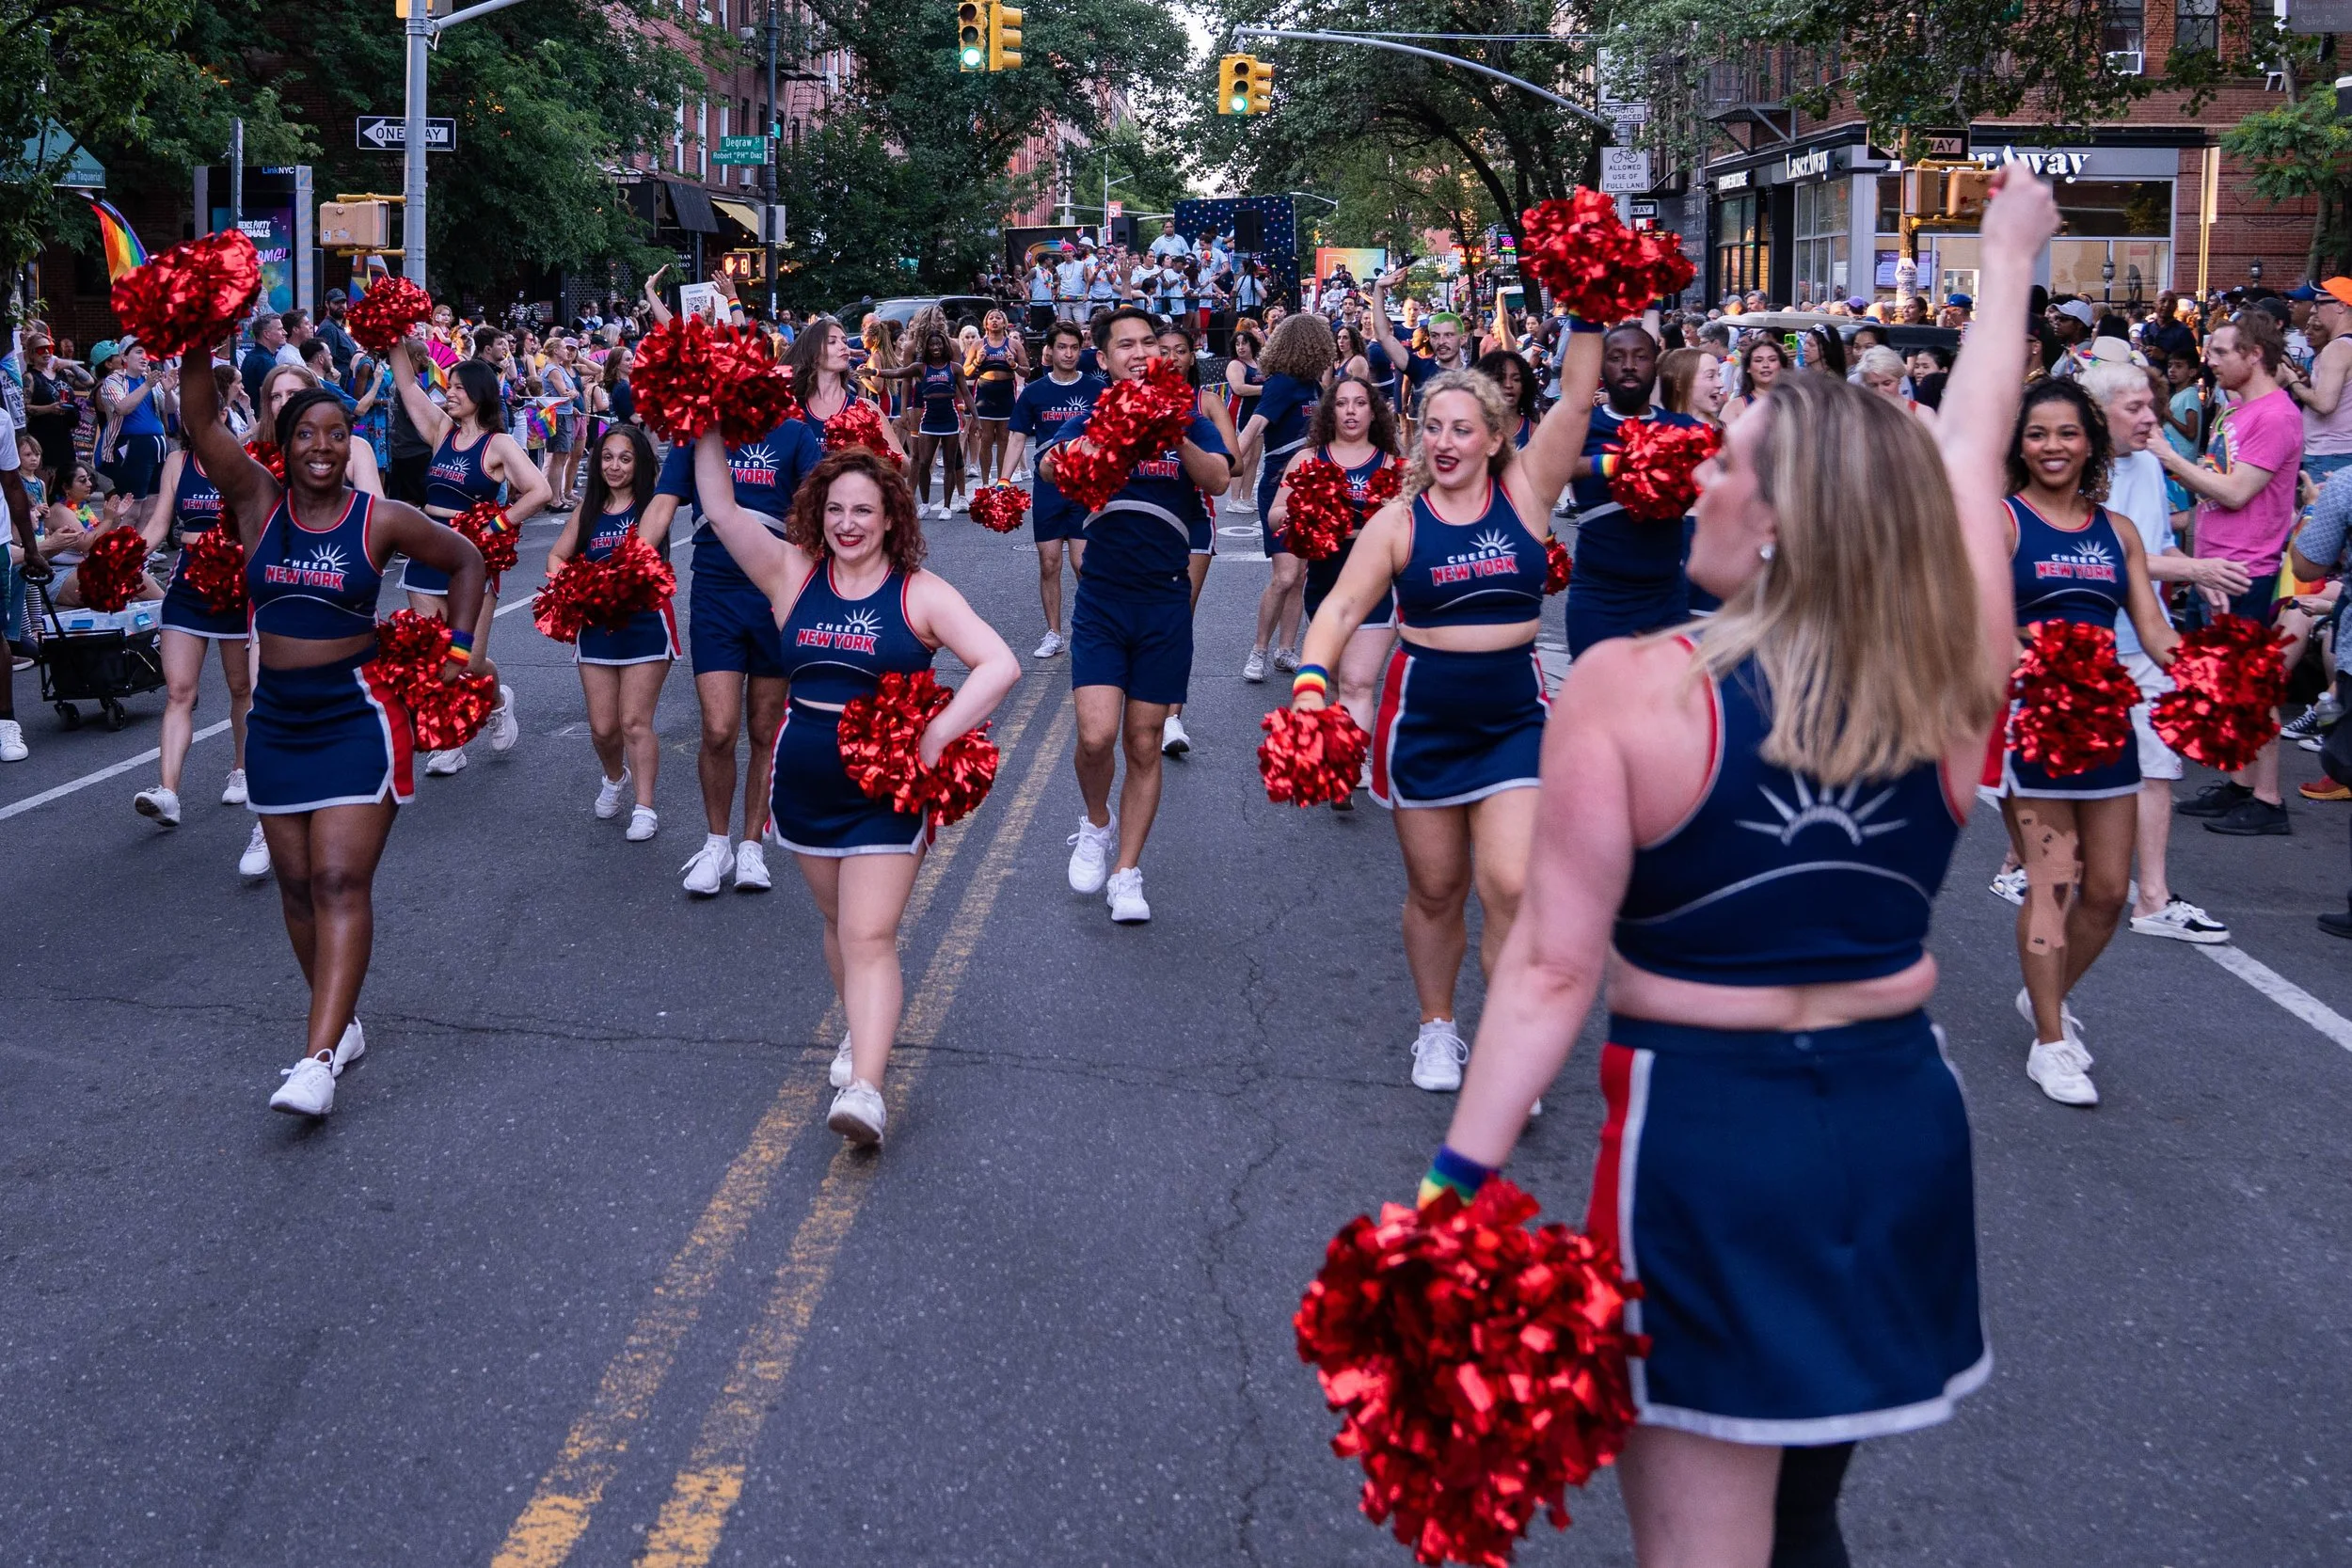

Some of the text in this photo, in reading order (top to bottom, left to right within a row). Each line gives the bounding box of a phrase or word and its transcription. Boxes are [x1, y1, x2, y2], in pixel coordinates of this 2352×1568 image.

[376, 127, 441, 140] ONE AY
[725, 137, 753, 150] Degraw
[1786, 147, 1830, 181] LaserAway
[1631, 205, 1650, 214] WAY
[1041, 411, 1063, 422] NEW
[437, 463, 459, 471] CHEER
[725, 459, 760, 468] HEER
[428, 466, 467, 485] NEW YORK
[735, 467, 777, 487] YORK
[183, 499, 204, 510] NEW
[590, 535, 613, 551] NEW
[1447, 548, 1498, 564] CHEER
[2051, 553, 2099, 564] CHEER
[1429, 554, 1520, 587] NEW YORK
[2033, 561, 2118, 584] NEW YORK
[265, 564, 345, 593] NEW YORK
[816, 622, 862, 634] CHEER
[796, 628, 877, 656] NEW YORK
